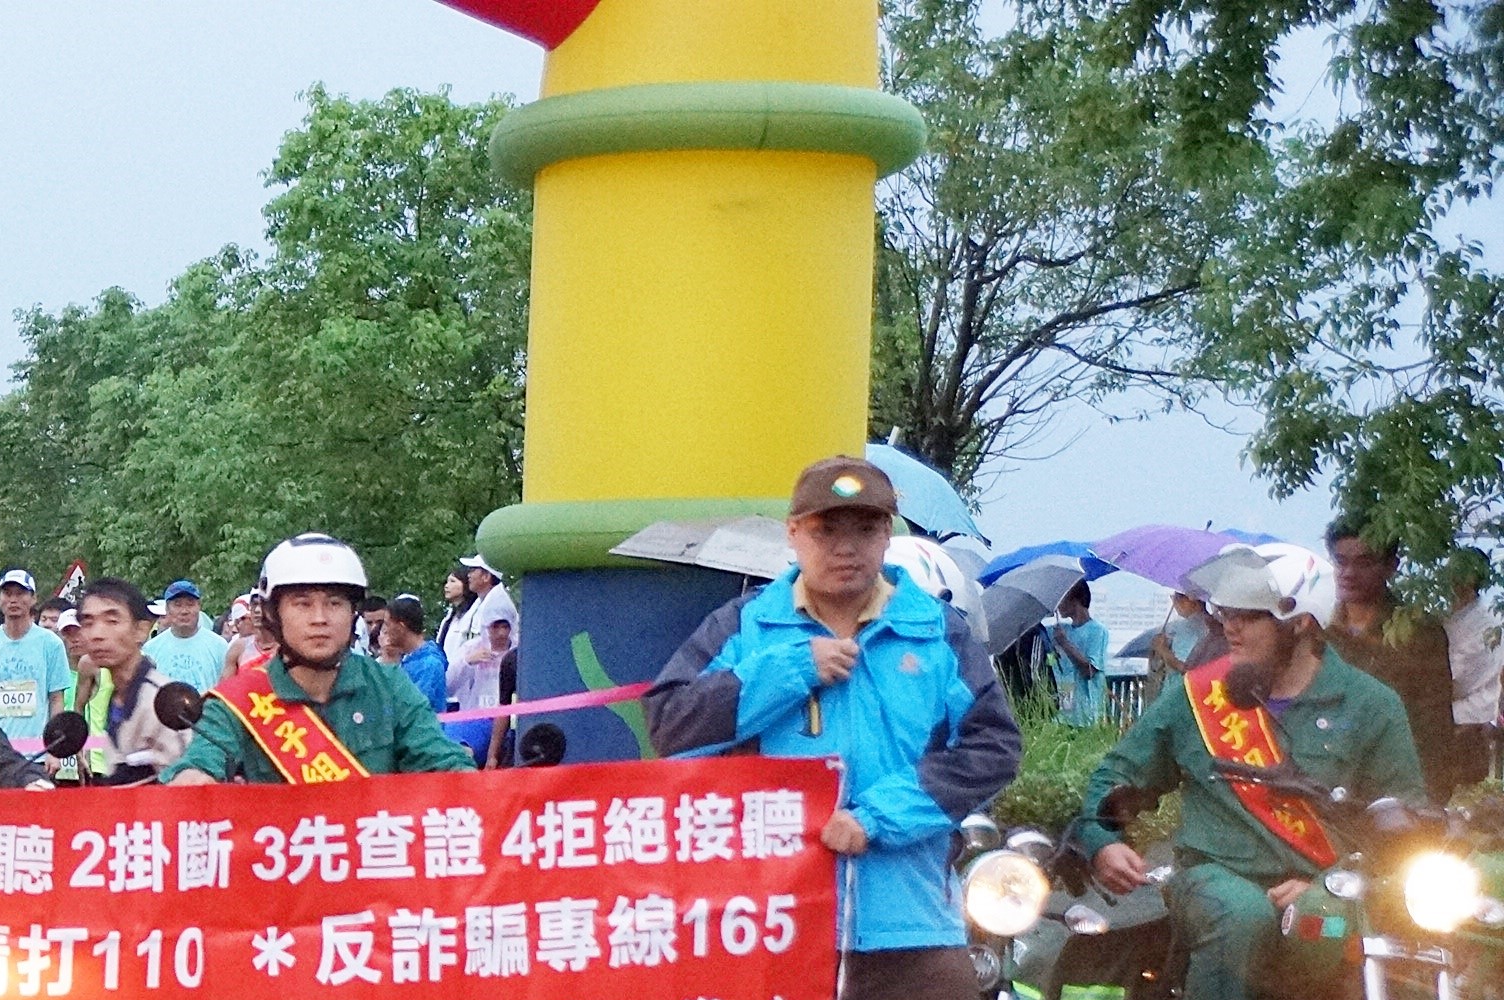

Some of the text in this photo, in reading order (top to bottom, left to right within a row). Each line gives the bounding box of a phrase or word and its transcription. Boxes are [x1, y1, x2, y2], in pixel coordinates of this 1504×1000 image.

[247, 691, 350, 784] 女子組
[70, 819, 231, 894] 2掛斷
[252, 806, 486, 886] 3先查證
[500, 788, 807, 870] 4拒絕接聽
[316, 893, 796, 986] 反詐騙專線165
